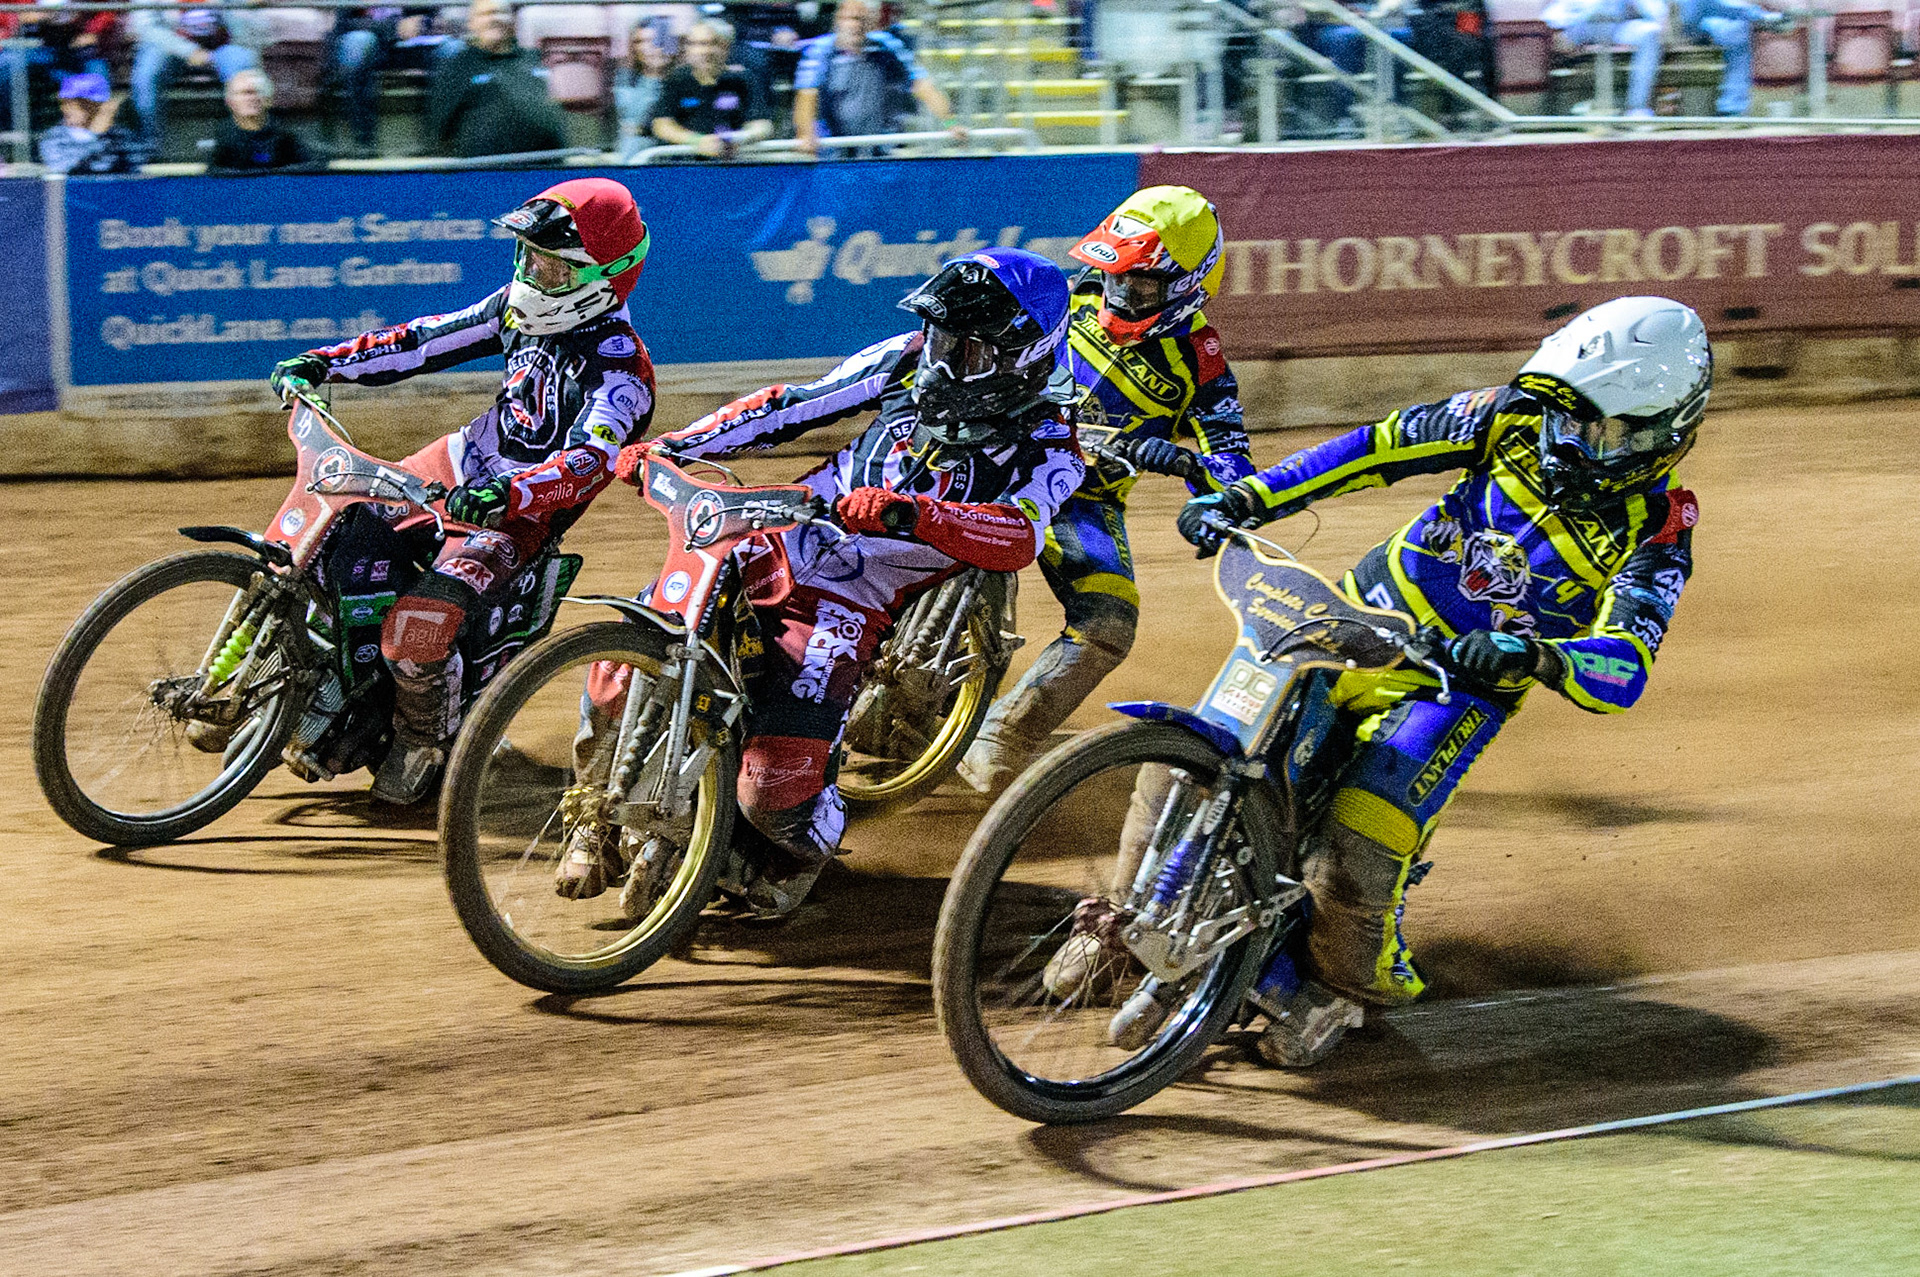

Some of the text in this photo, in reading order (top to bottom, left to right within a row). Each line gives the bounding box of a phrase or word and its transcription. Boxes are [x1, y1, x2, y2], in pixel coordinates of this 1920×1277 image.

[195, 223, 274, 252] your
[358, 212, 487, 242] Service
[1090, 244, 1117, 261] Arai
[1222, 223, 1786, 297] THORNEYCROFT
[101, 265, 139, 293] at
[141, 261, 248, 296] Quick
[250, 258, 335, 289] Lane
